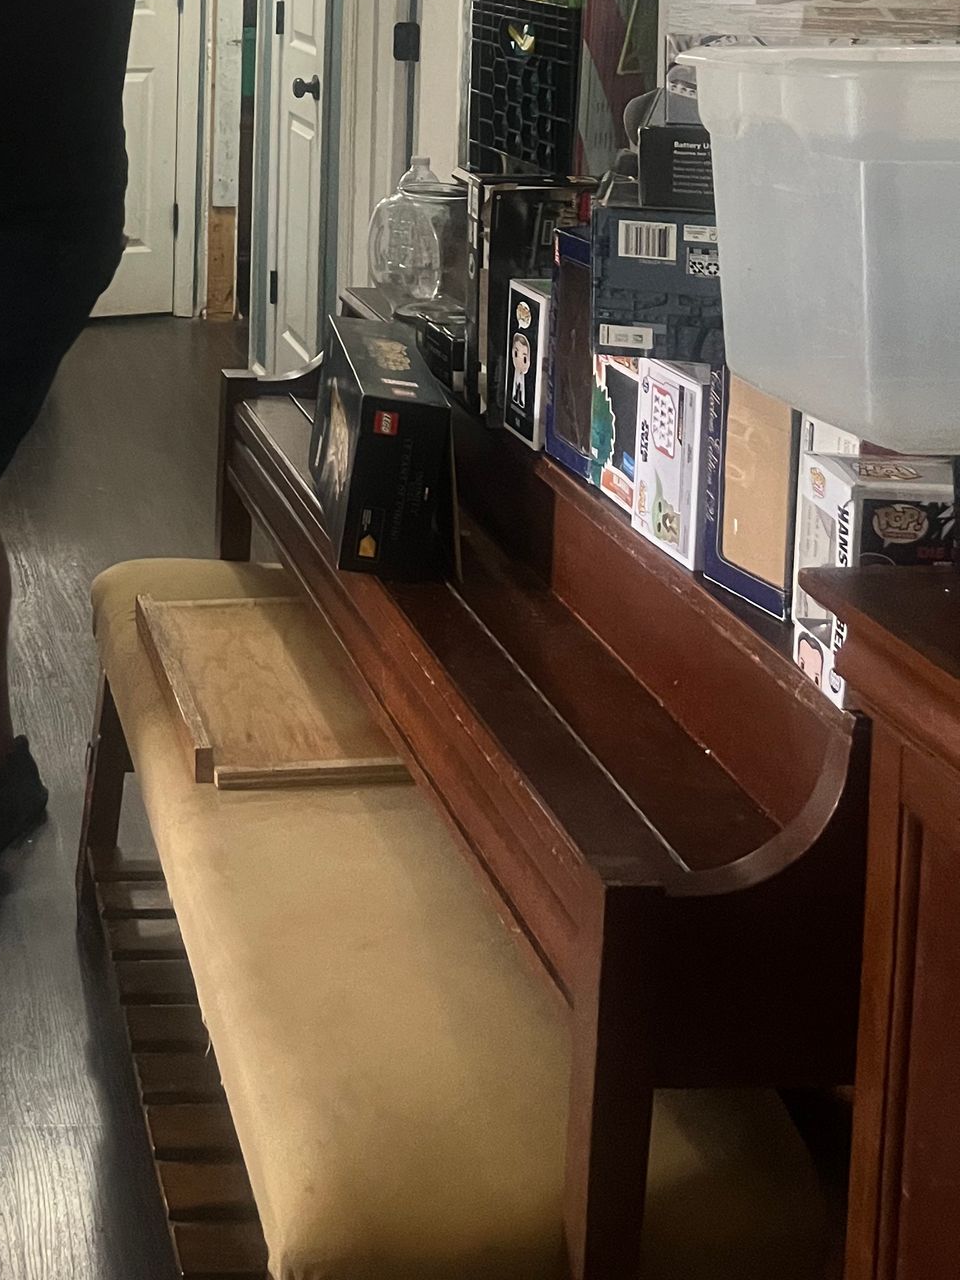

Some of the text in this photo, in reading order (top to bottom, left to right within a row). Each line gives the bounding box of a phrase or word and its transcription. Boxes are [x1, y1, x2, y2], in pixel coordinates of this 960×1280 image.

[673, 141, 702, 150] Battery
[381, 413, 392, 433] LEGO
[874, 506, 927, 532] POP!
